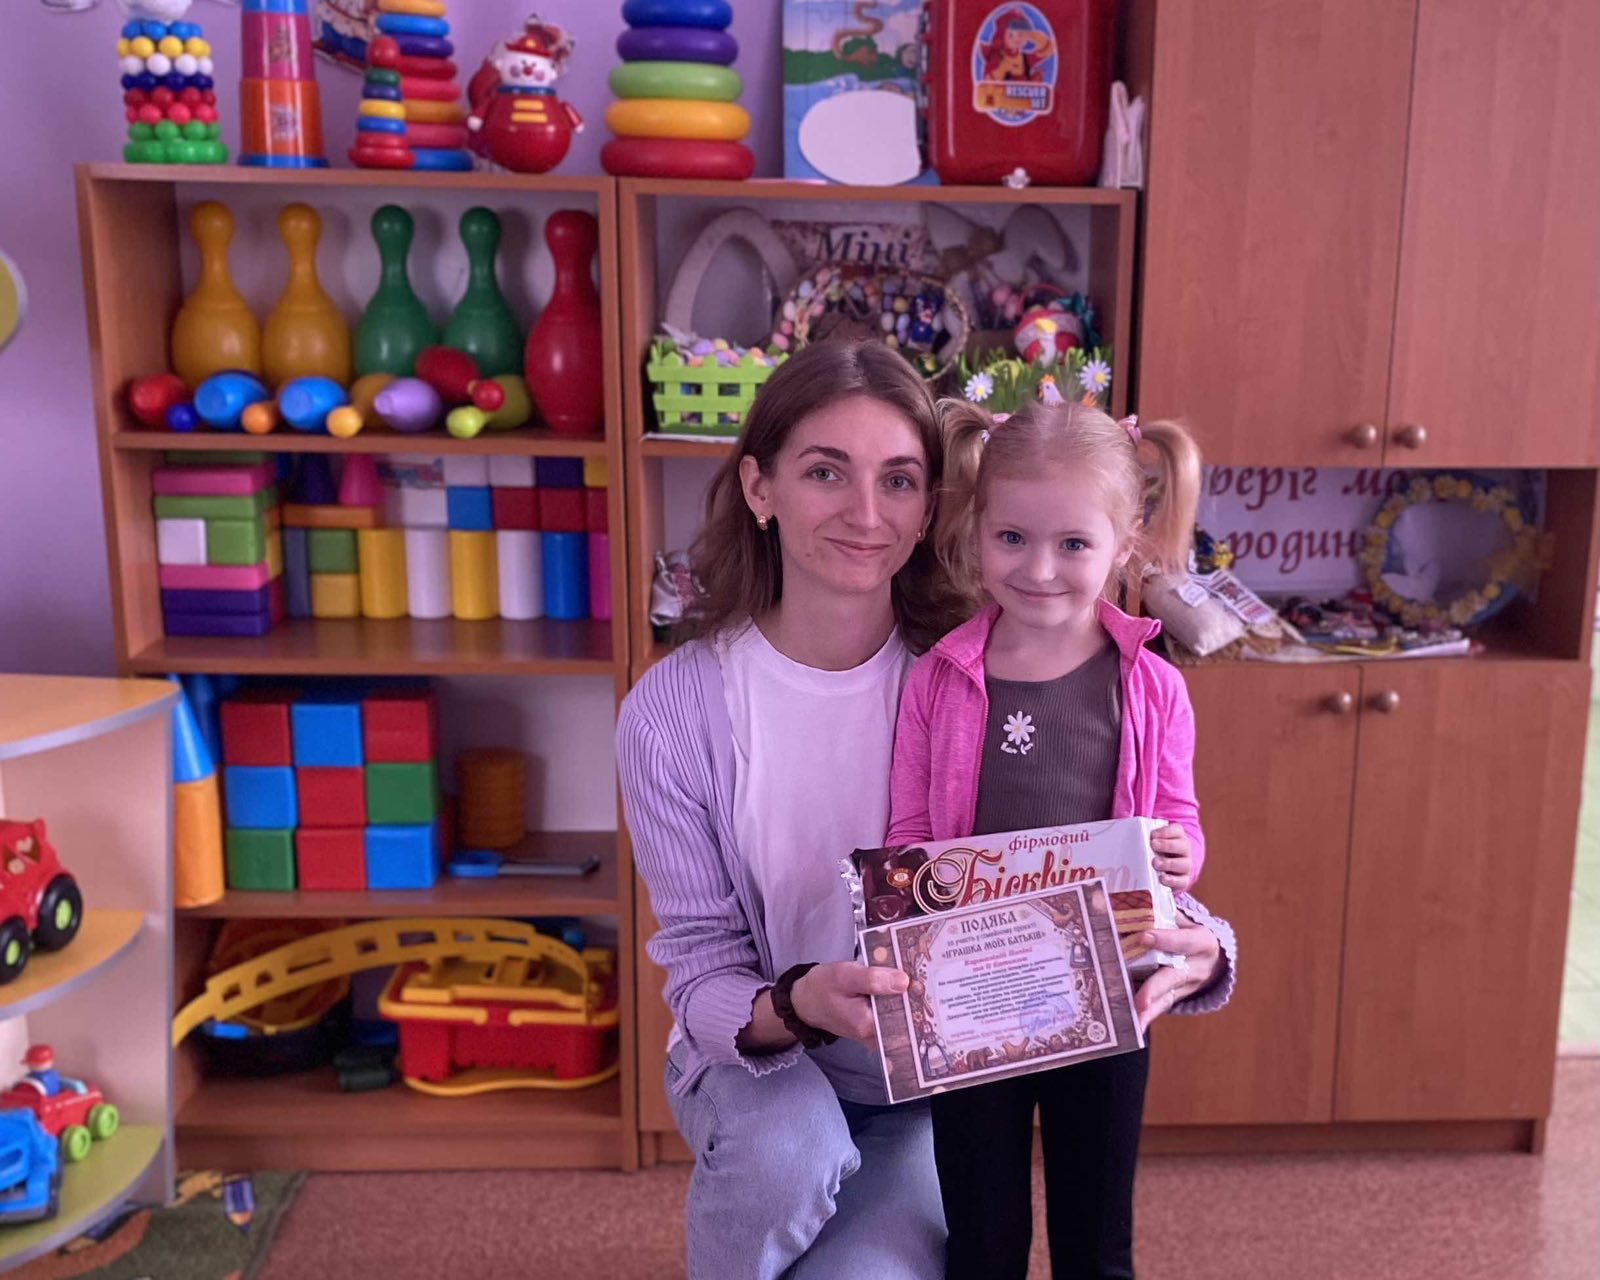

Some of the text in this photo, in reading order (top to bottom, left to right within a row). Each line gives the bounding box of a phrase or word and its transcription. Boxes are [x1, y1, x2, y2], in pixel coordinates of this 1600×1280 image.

[1006, 86, 1047, 98] RESCUER
[1031, 98, 1046, 110] SET
[814, 229, 912, 265] Міні
[1008, 829, 1090, 854] фірмовий
[961, 911, 1018, 933] ПОДЯКА
[984, 937, 1006, 951] МОЇХ
